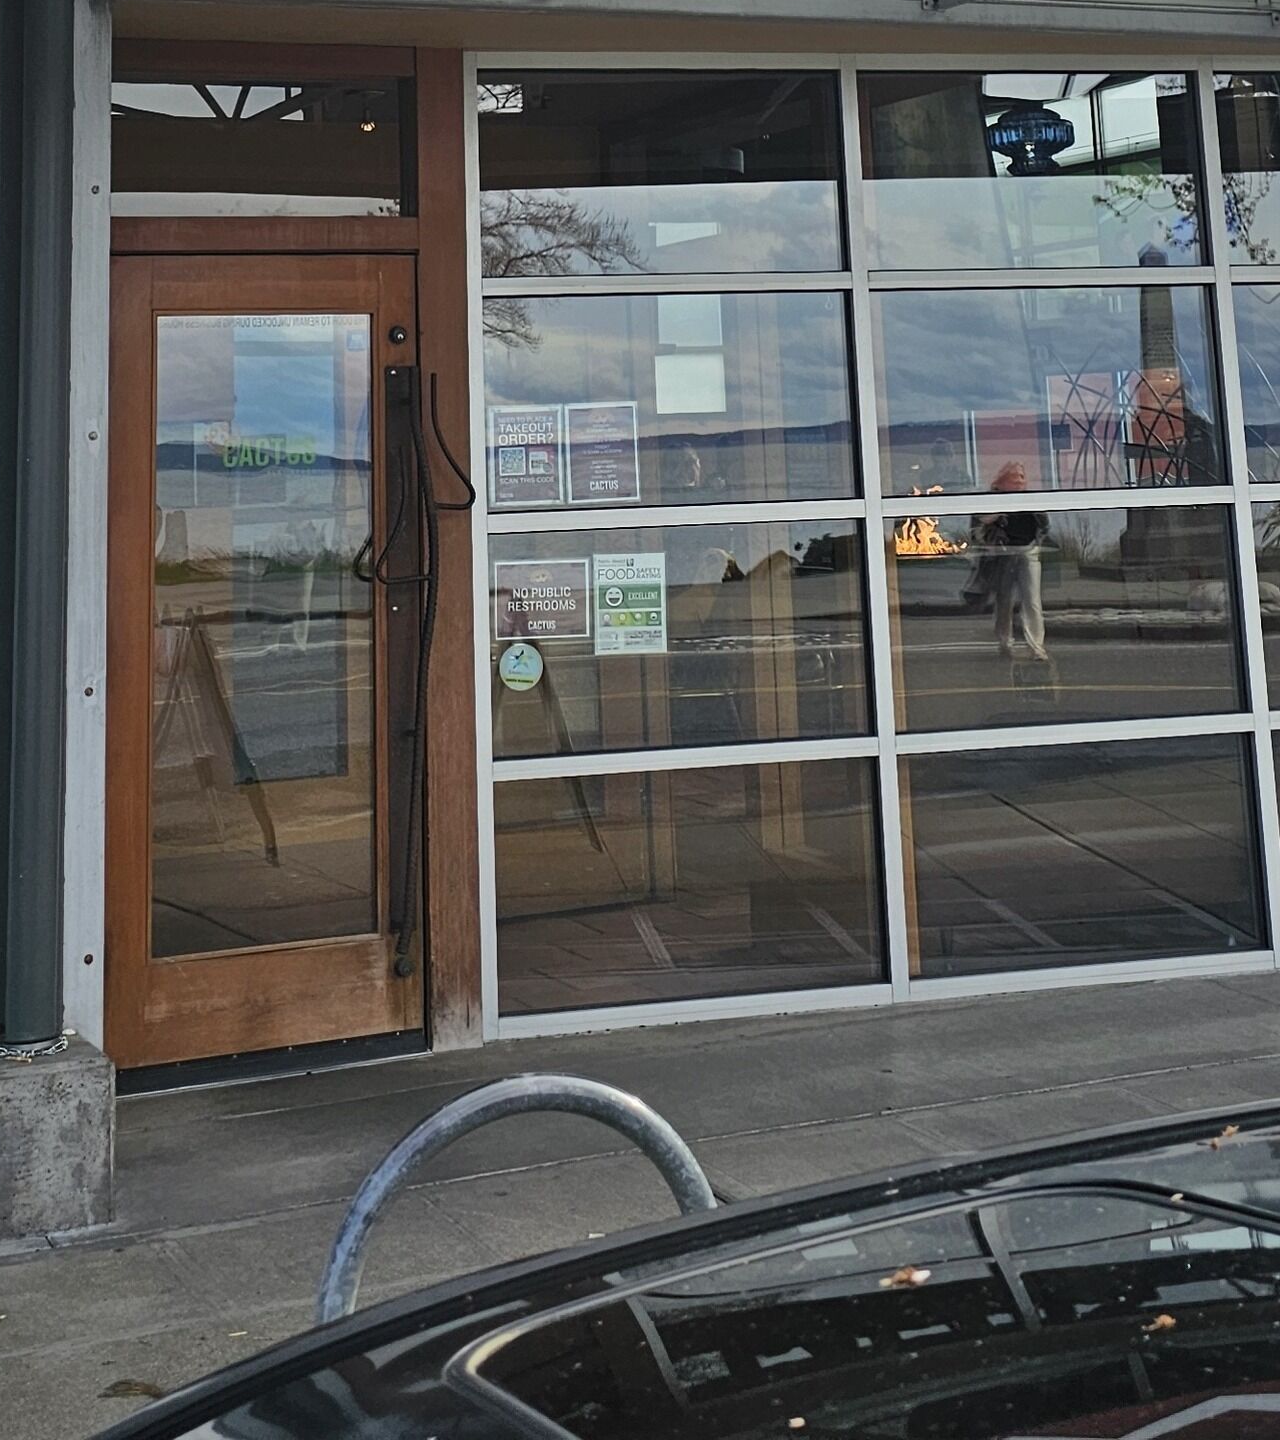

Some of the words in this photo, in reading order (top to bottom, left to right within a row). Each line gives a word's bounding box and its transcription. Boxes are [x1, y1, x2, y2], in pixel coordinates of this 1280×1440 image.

[499, 422, 553, 433] TAKEOUT
[498, 432, 554, 446] ORDER?
[223, 437, 317, 468] CACTUS
[589, 479, 619, 491] CACTUS
[598, 568, 636, 580] FOOD
[512, 587, 529, 599] NO
[531, 586, 572, 598] PUBLIC
[628, 591, 658, 601] EXCELLENT
[507, 599, 577, 612] RESTROOMS
[527, 620, 557, 631] CACTUS
